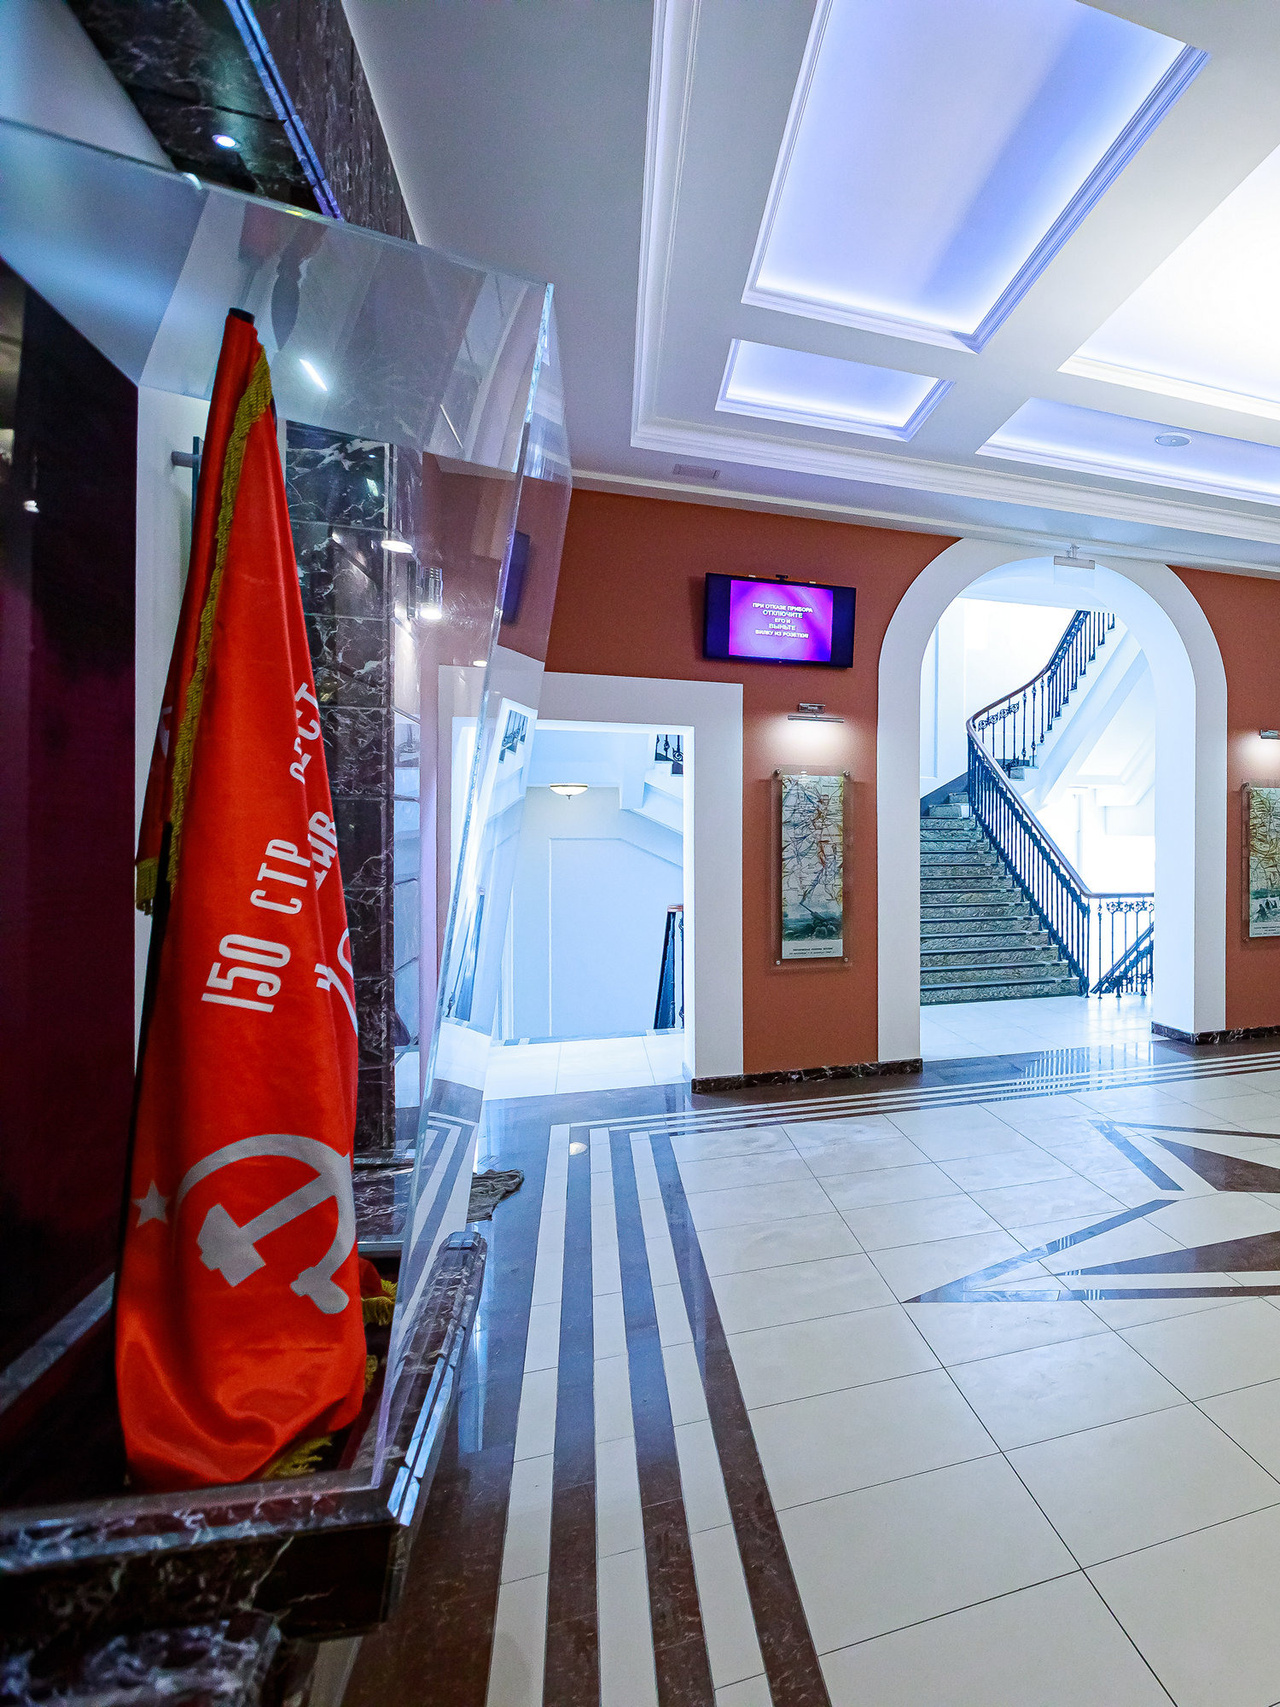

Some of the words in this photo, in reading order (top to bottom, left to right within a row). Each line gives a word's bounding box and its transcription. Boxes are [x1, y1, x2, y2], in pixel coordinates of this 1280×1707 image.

[762, 609, 803, 618] ОТКЛЮЧИТЕ
[769, 623, 796, 631] ВЫНЬТЕ
[201, 934, 291, 1013] 150
[250, 839, 312, 915] СТР
